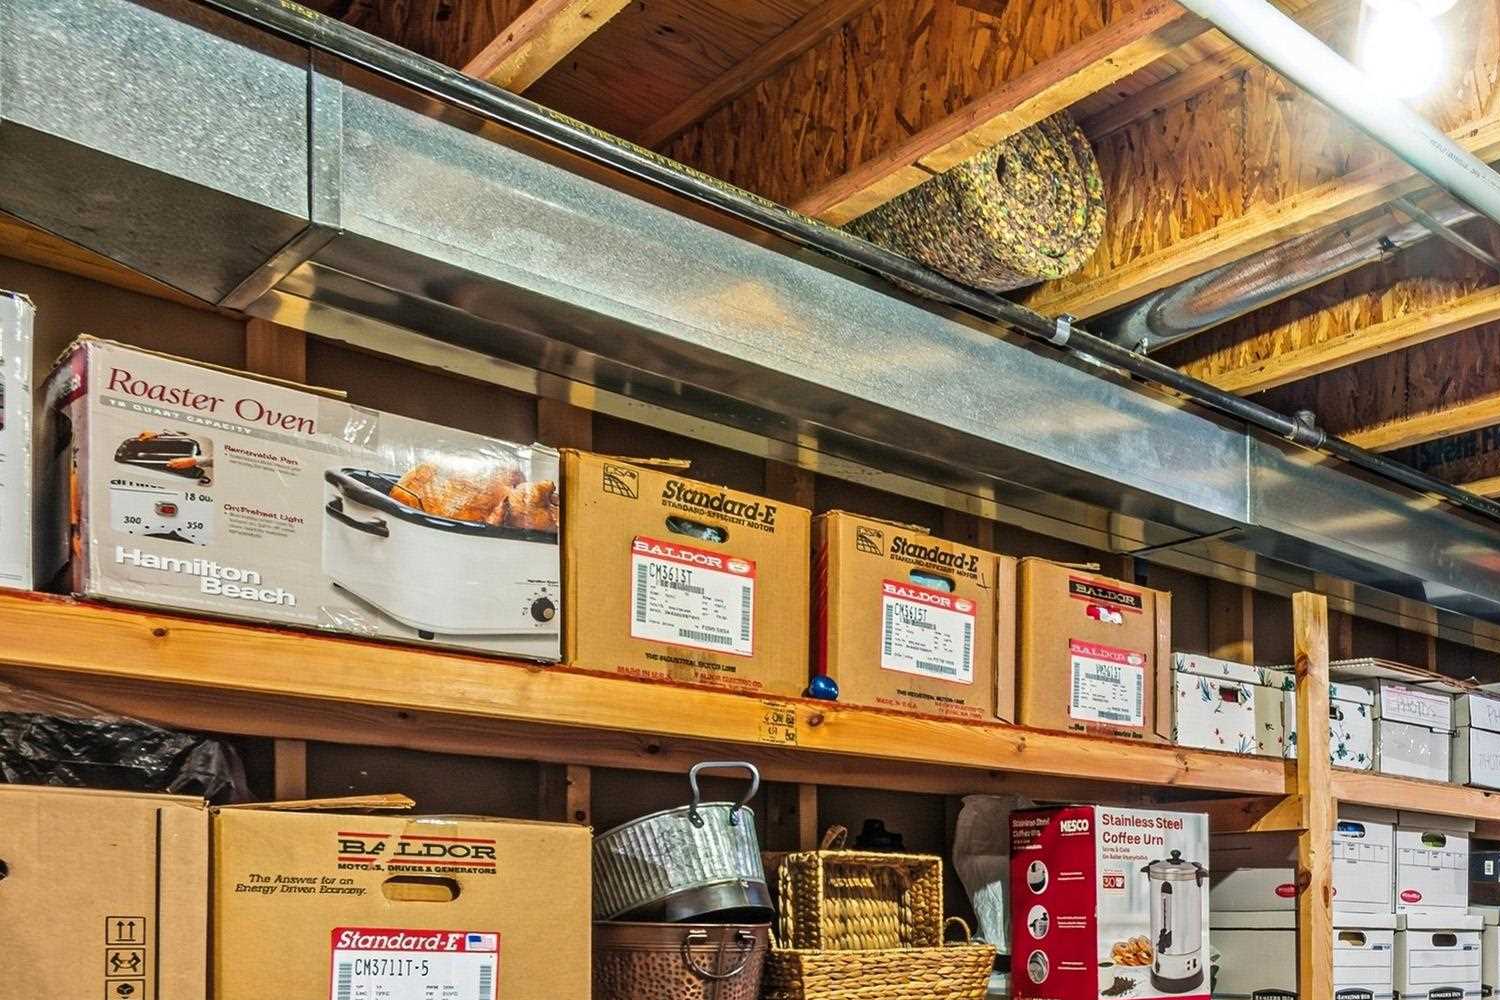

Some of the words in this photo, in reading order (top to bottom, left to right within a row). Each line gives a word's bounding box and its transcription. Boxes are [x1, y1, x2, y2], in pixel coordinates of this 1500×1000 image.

[107, 367, 225, 413] Roaster
[235, 398, 315, 435] Oven
[133, 404, 182, 419] QUART
[187, 414, 253, 434] CAPACITY
[662, 480, 778, 525] Standard-E
[123, 516, 142, 525] 300
[187, 521, 204, 530] 350
[115, 545, 262, 585] Hamilton
[633, 540, 723, 569] BALDOR
[890, 535, 979, 573] Standard-E
[200, 577, 297, 606] Beach
[883, 582, 952, 609] BALDOR
[1075, 583, 1137, 607] BALDOR
[1060, 818, 1090, 833] NESCO
[1102, 813, 1155, 829] Stainless
[1156, 817, 1184, 830] Steel
[337, 839, 497, 860] BALDOR
[1102, 831, 1141, 845] Coffee
[1143, 833, 1164, 846] Urn
[235, 883, 277, 895] Energy
[279, 885, 317, 894] Driven
[248, 873, 271, 885] The
[336, 930, 464, 951] Standard-E
[354, 958, 430, 977] CM3711T-5
